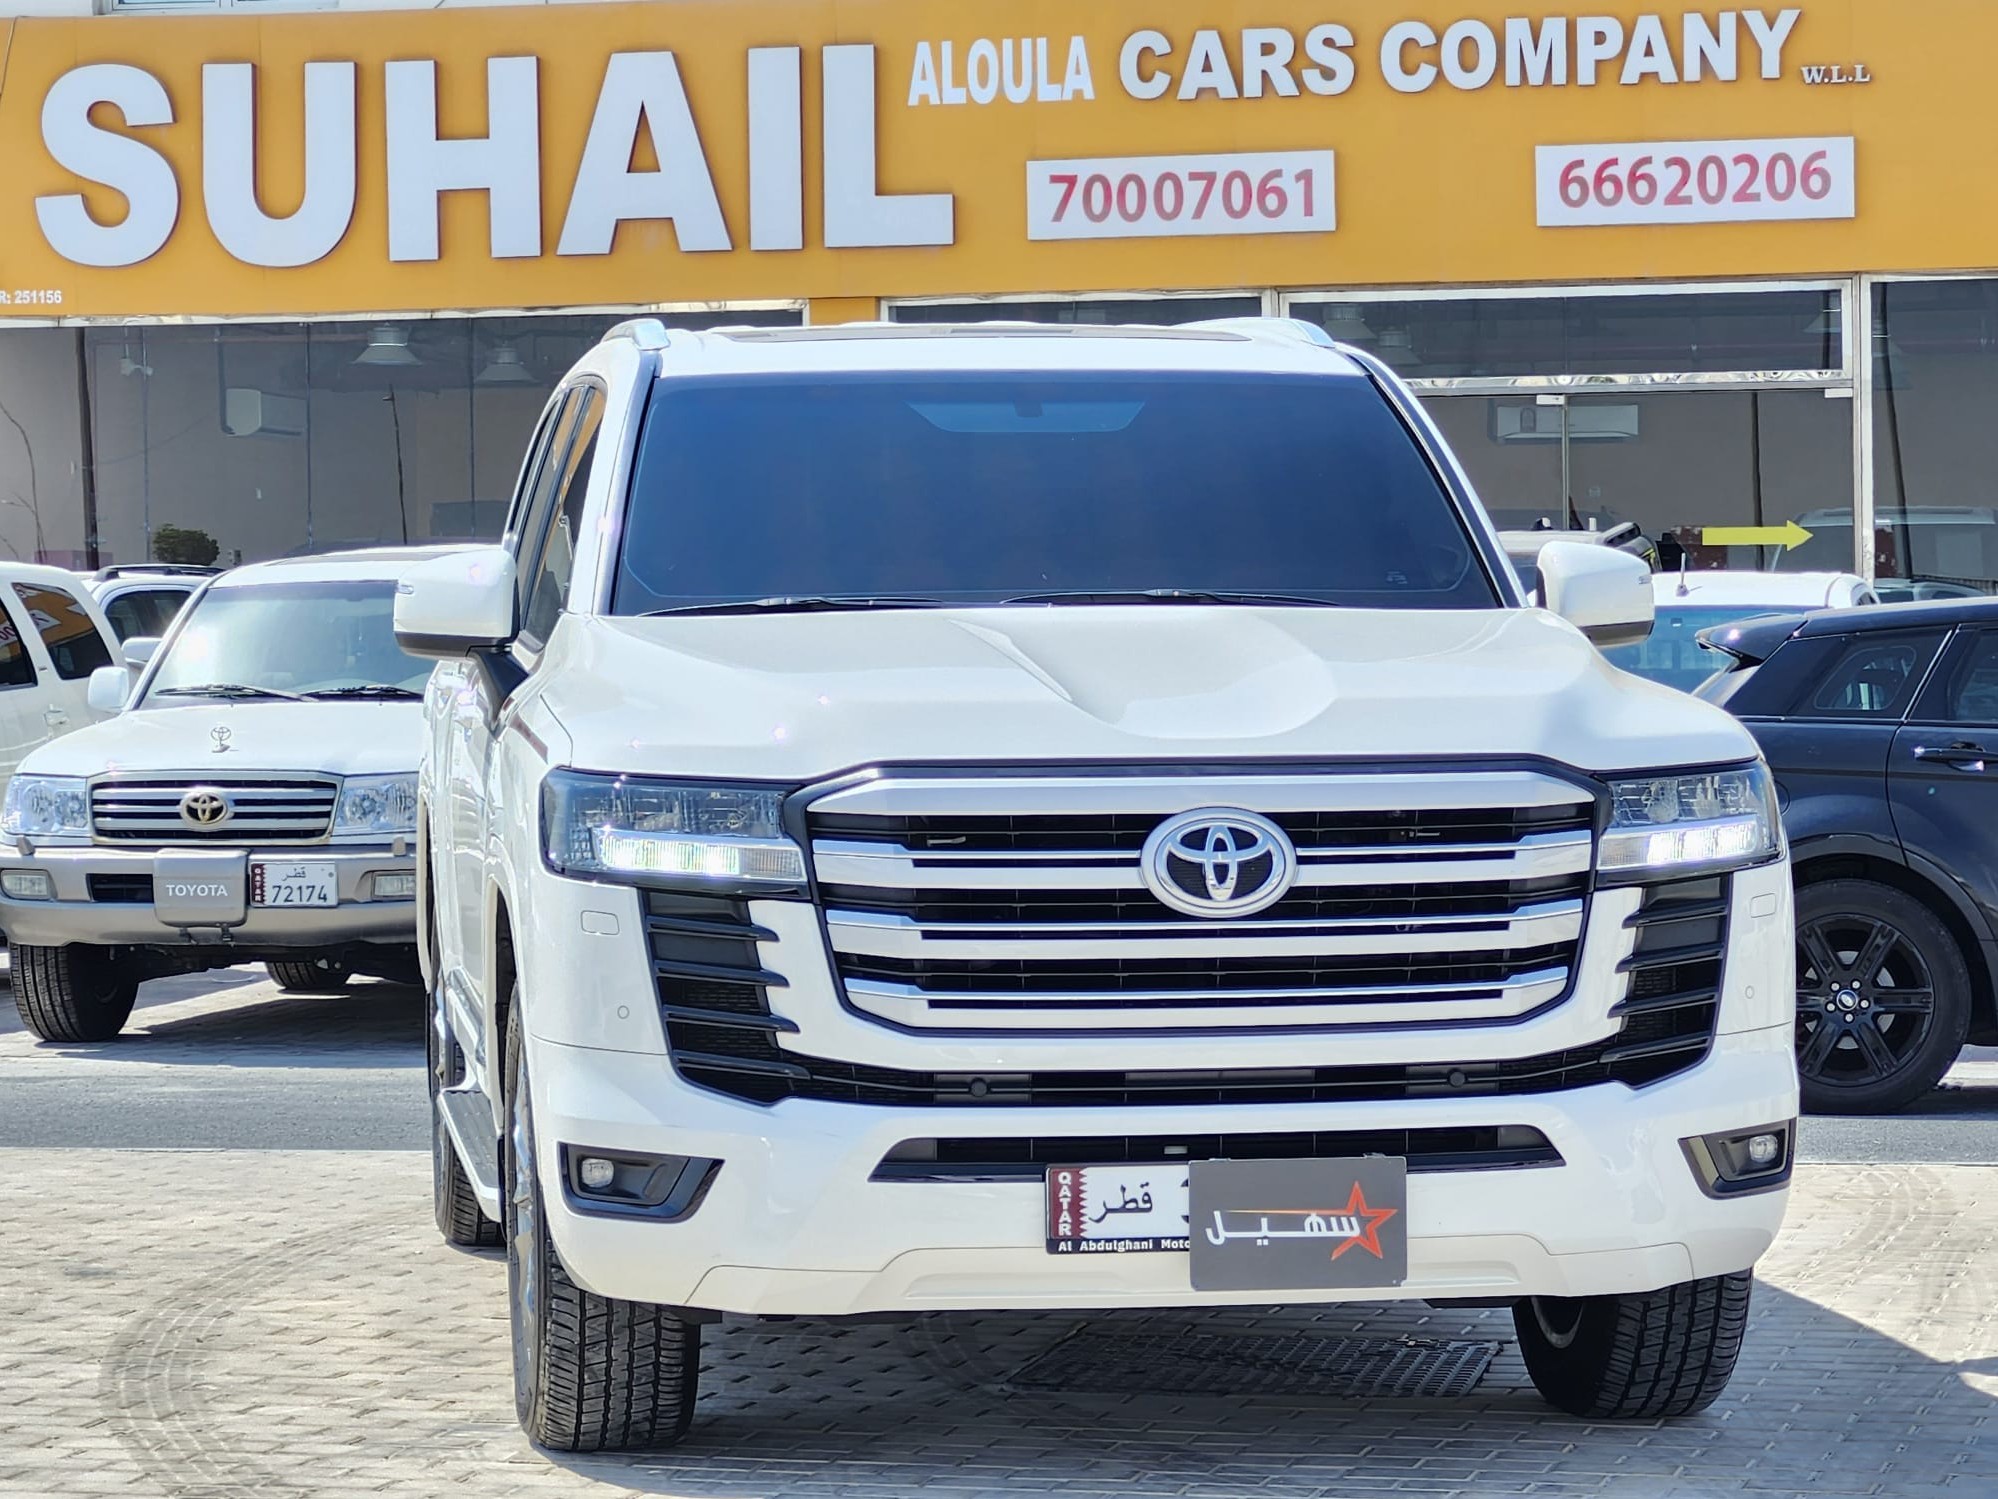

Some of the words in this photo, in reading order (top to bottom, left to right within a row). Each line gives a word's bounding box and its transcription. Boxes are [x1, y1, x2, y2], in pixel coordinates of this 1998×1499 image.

[906, 34, 1096, 107] ALOULA
[1119, 23, 1355, 100] CARS
[1380, 8, 1800, 93] COMPANY
[1801, 64, 1871, 84] W.L.L
[34, 44, 956, 268] SUHAIL
[1049, 168, 1314, 223] 70007061
[1558, 150, 1832, 208] 66620206
[14, 289, 62, 304] 251156
[166, 884, 229, 897] TOYOTA
[254, 868, 262, 902] QATAR
[281, 866, 307, 882] قطر
[272, 885, 328, 903] 72174
[1057, 1172, 1072, 1237] QATAR
[1088, 1181, 1153, 1224] قطر
[1058, 1241, 1072, 1252] Al
[1080, 1241, 1153, 1253] Abdulghani
[1205, 1210, 1361, 1247] سهيل
